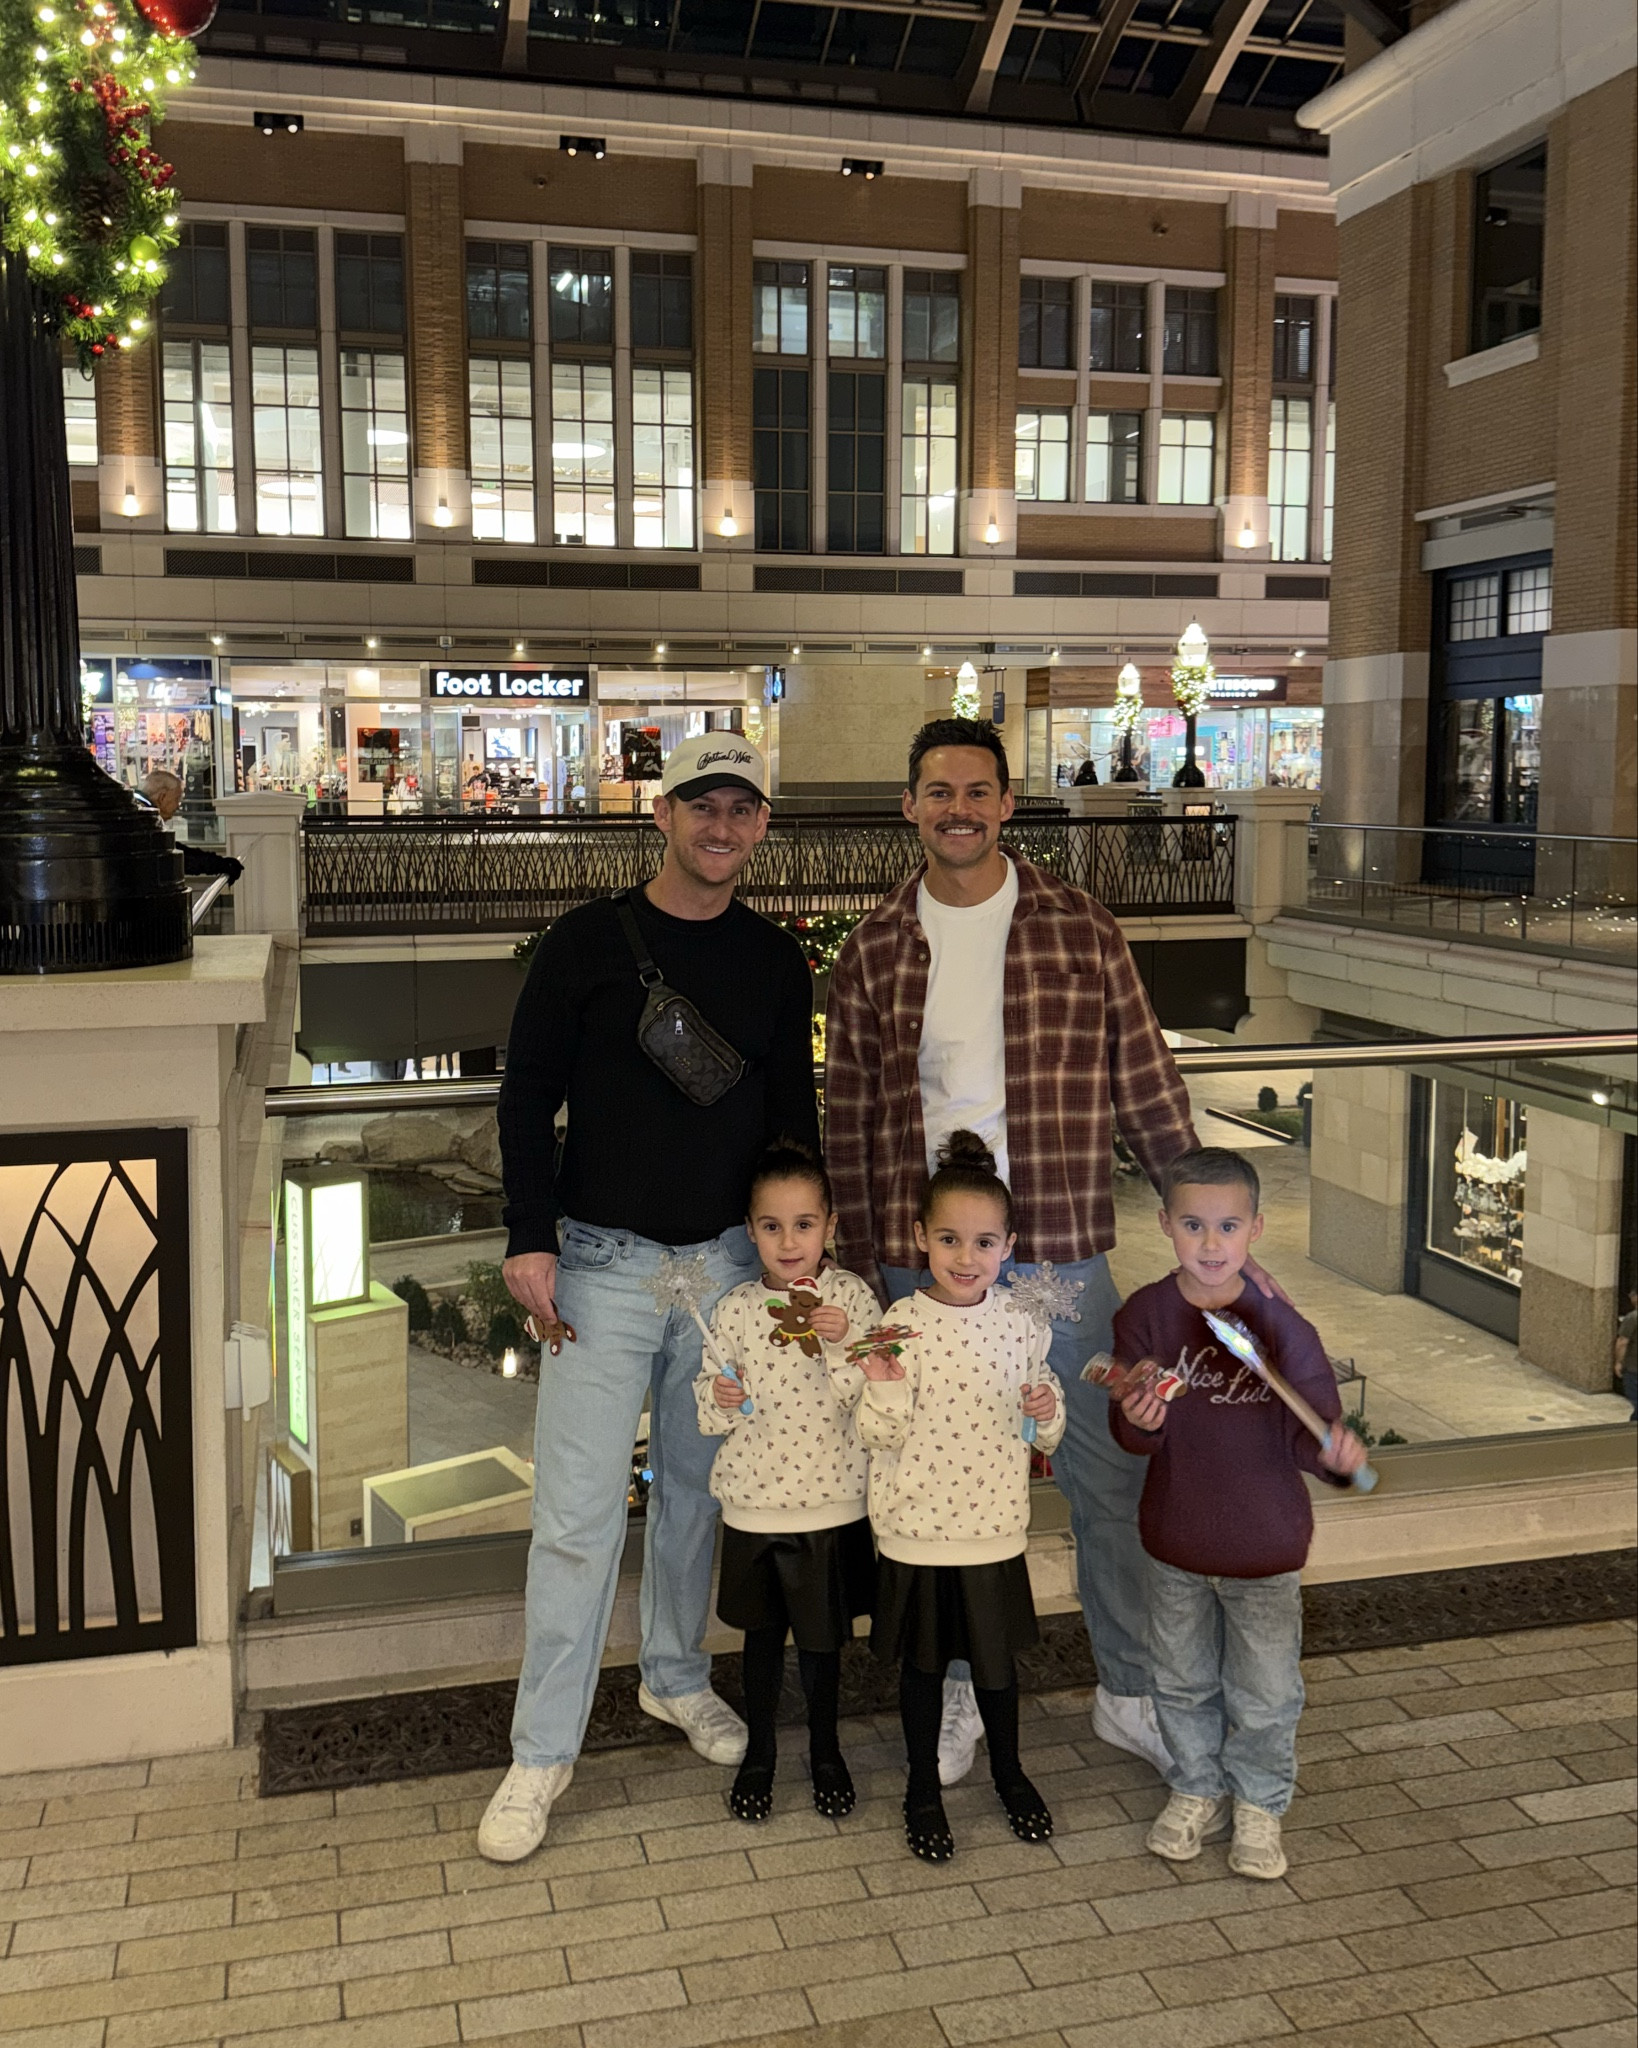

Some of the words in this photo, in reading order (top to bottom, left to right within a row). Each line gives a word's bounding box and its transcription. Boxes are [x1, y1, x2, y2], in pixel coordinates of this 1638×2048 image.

[436, 671, 492, 695] Foot
[499, 672, 584, 696] Locker
[291, 1196, 300, 1319] CUSTOMER
[293, 1330, 302, 1424] SERVICE
[1158, 1345, 1225, 1390] Nice
[1210, 1364, 1272, 1404] List
